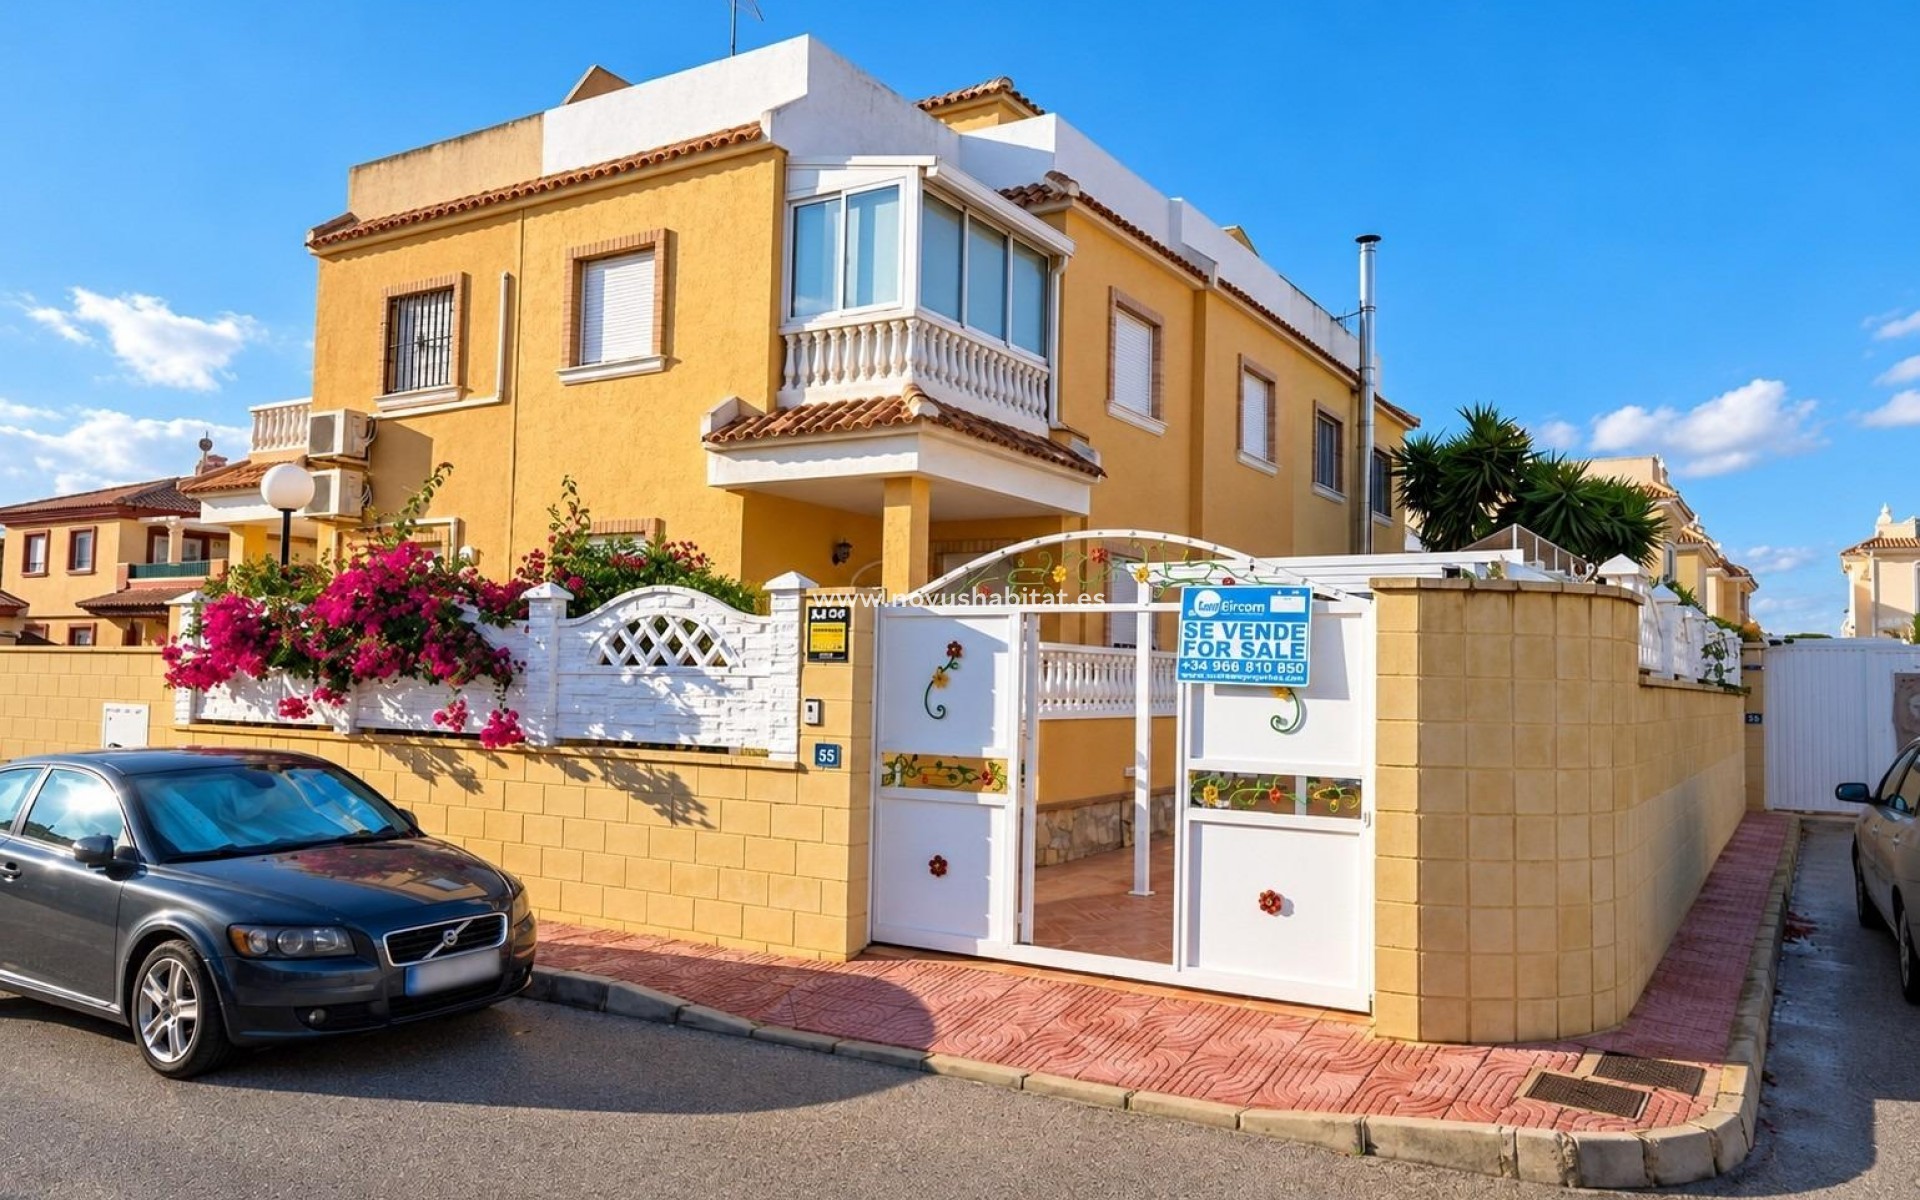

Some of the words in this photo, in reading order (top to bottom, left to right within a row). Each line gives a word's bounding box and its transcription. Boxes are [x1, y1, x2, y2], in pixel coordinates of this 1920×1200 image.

[1184, 622, 1214, 639] SE
[1221, 622, 1306, 640] VENDE
[1183, 640, 1231, 657] FOR
[1240, 641, 1305, 659] SALE
[1181, 660, 1208, 671] +34
[1244, 661, 1272, 674] 810
[1277, 662, 1305, 674] 850
